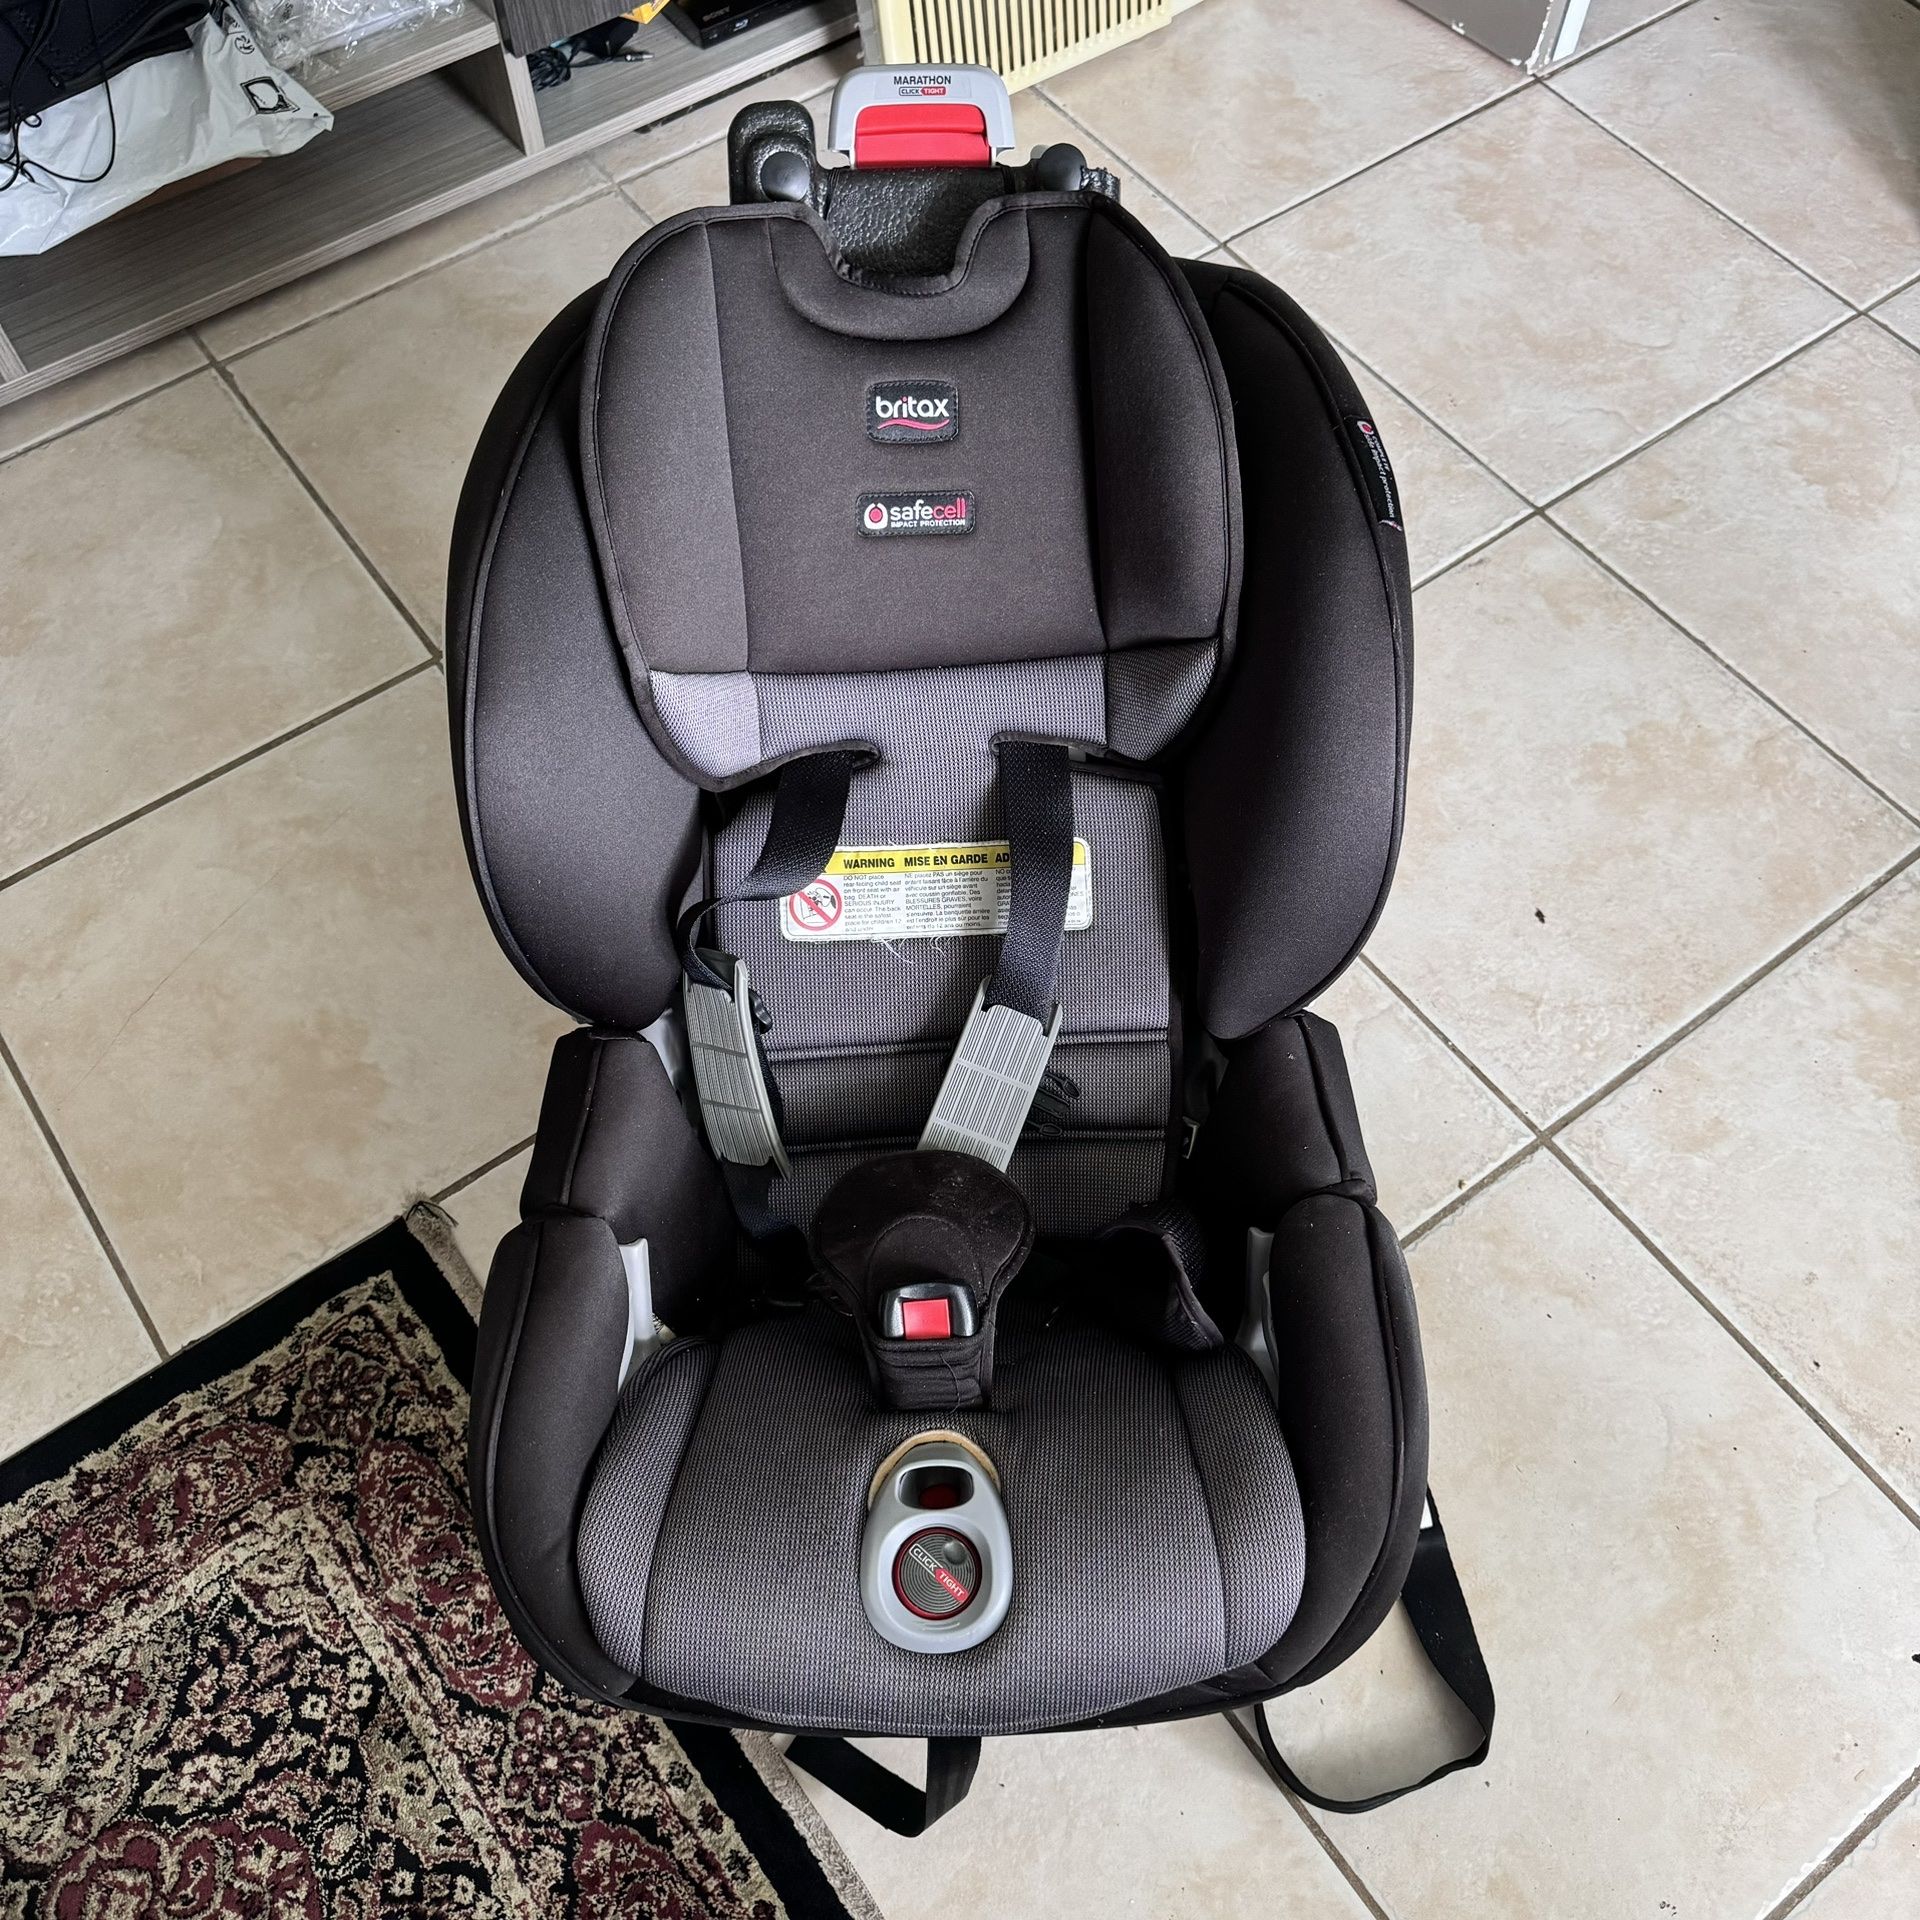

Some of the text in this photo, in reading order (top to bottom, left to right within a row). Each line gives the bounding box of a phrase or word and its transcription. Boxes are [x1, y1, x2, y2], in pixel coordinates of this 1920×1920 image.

[893, 75, 952, 85] MARATHON
[875, 396, 950, 418] britax
[1379, 475, 1395, 518] protection
[890, 497, 966, 521] safecell
[890, 518, 966, 528] IMPACT PROTECTION
[843, 858, 895, 869] WARNING
[904, 856, 931, 867] MISE
[933, 855, 948, 866] EN
[950, 853, 989, 865] GARDE
[913, 1548, 965, 1597] CLICK TIGHT
